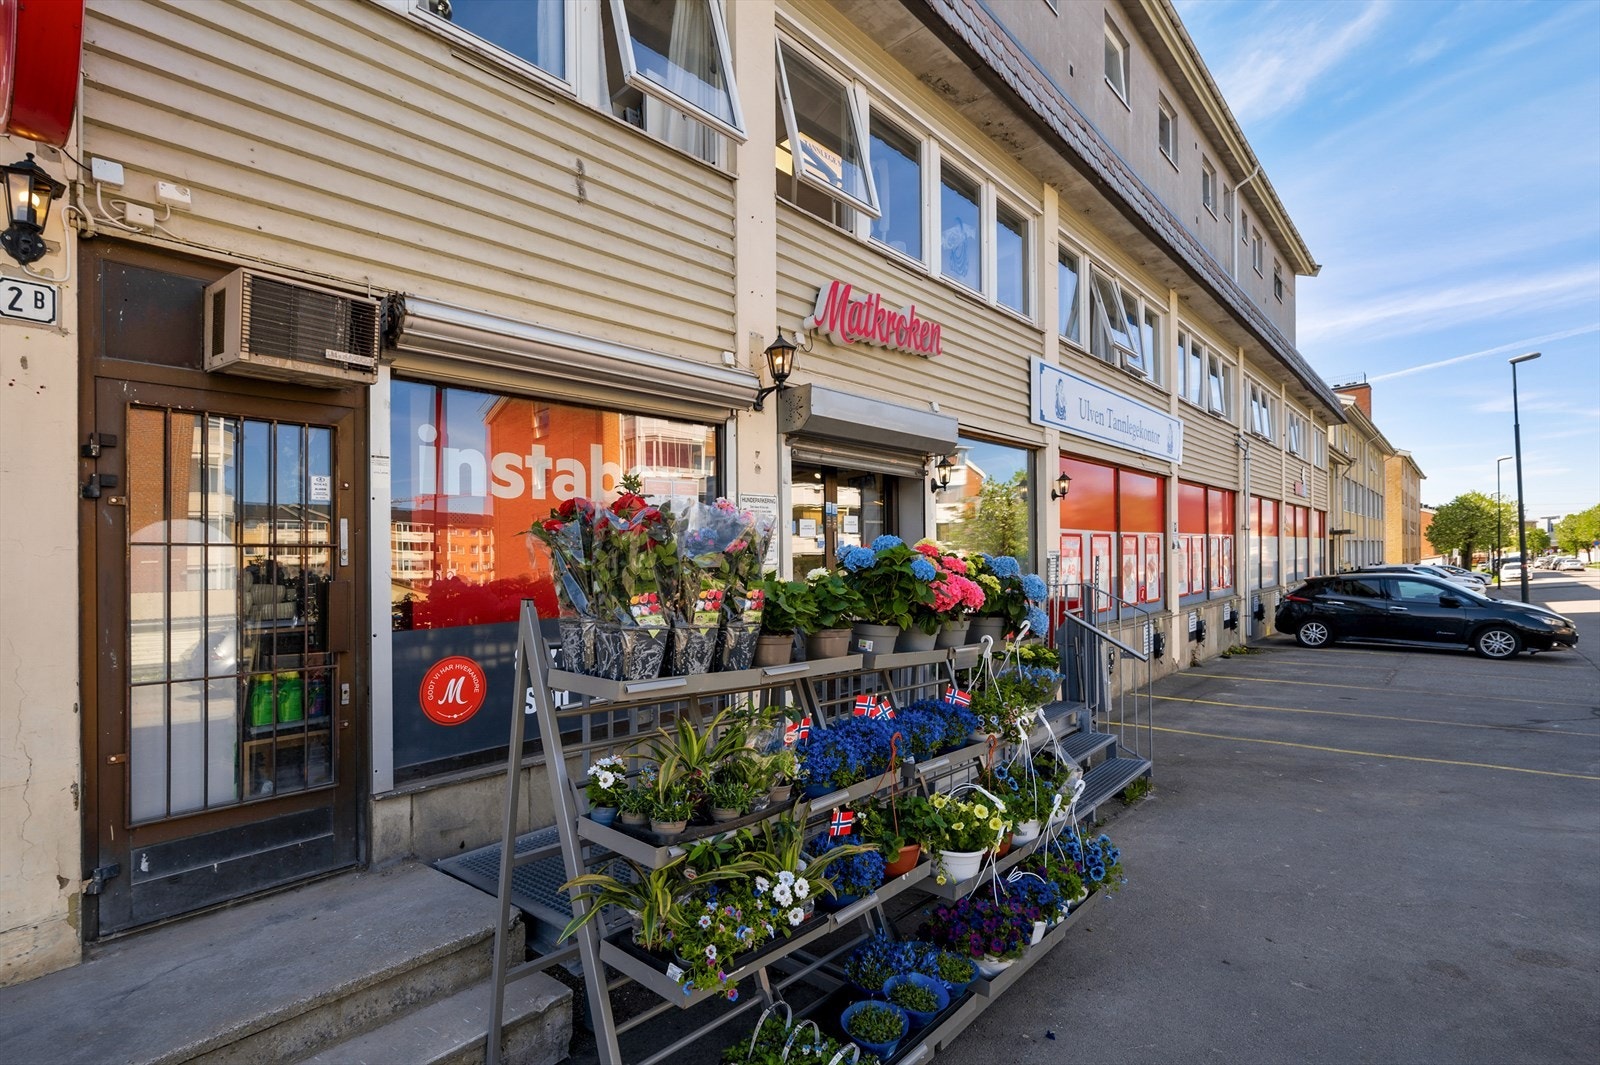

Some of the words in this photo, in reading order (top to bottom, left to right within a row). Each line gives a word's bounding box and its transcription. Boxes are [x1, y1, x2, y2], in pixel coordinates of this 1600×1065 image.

[8, 286, 23, 312] 2
[34, 290, 45, 310] B
[814, 280, 943, 355] Matkroken
[1078, 397, 1105, 427] Ulven
[1107, 408, 1161, 445] Tannlegekontor
[427, 680, 436, 701] GODT
[433, 672, 441, 680] VI
[439, 663, 454, 675] HAR
[454, 663, 480, 693] HVERANDRE
[438, 676, 468, 705] M
